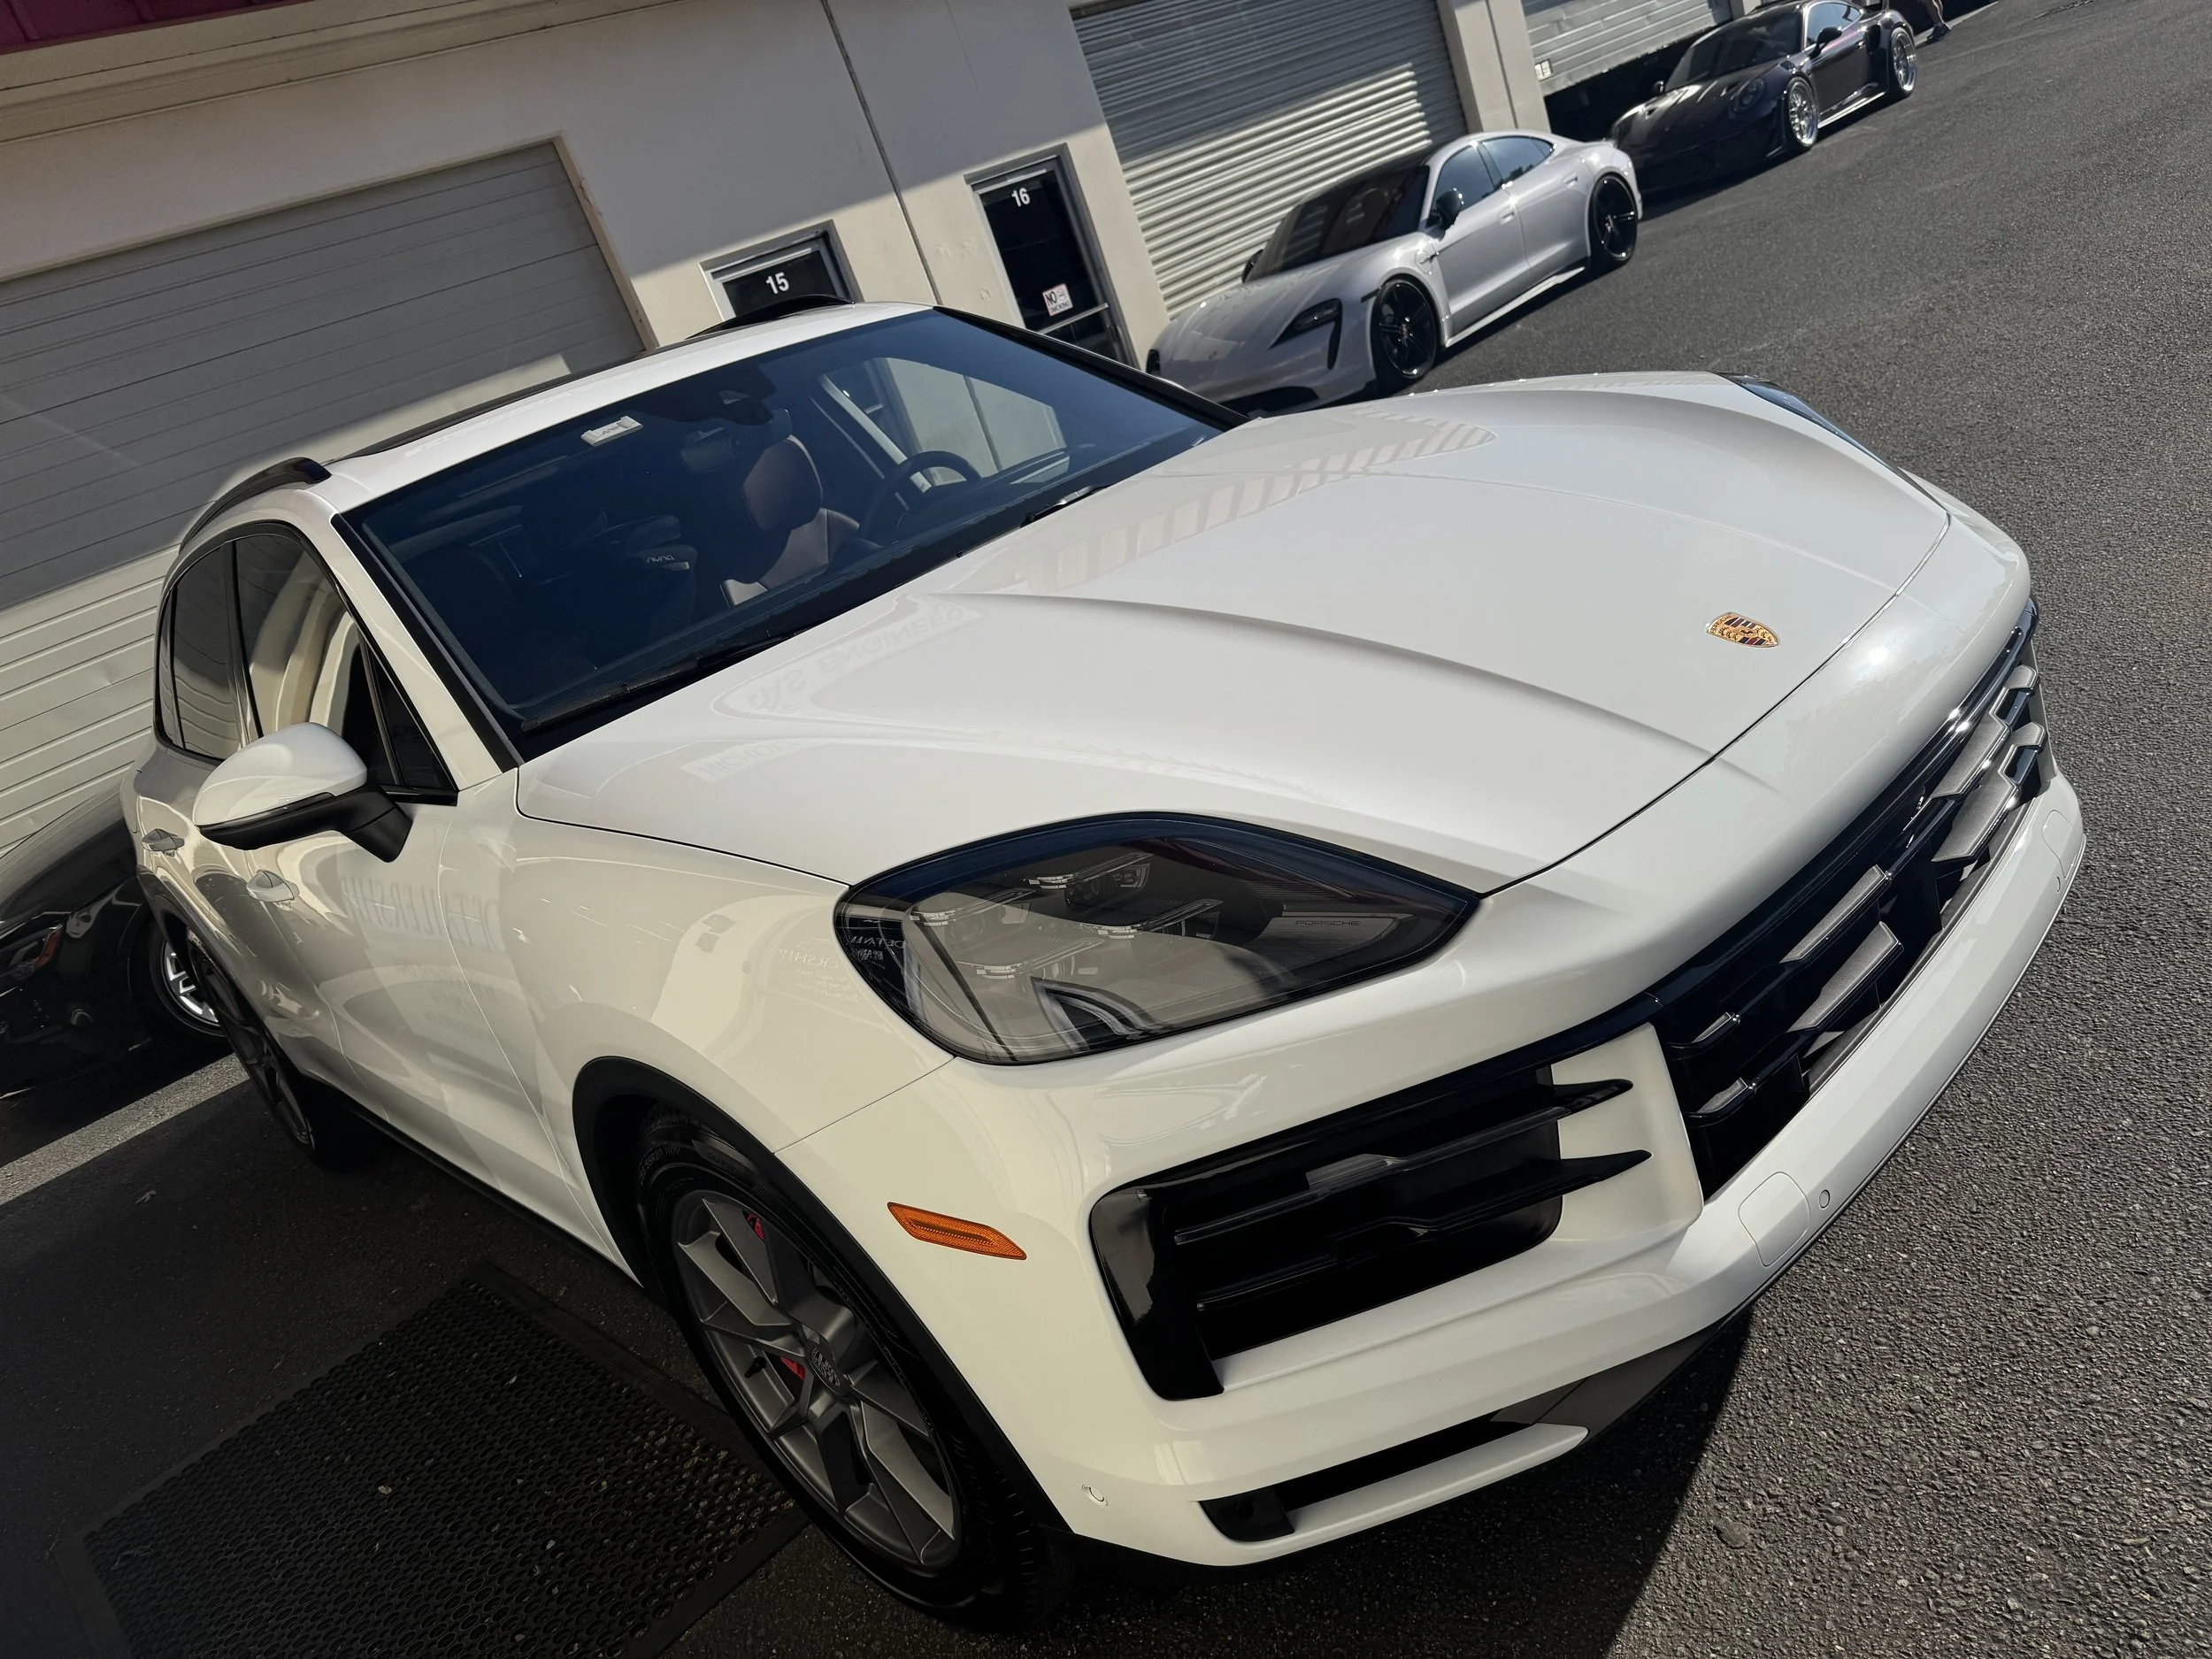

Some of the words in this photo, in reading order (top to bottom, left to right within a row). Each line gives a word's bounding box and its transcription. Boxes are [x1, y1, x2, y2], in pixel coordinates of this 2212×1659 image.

[1011, 188, 1030, 206] 16
[765, 272, 789, 294] 15
[1045, 291, 1057, 305] NO
